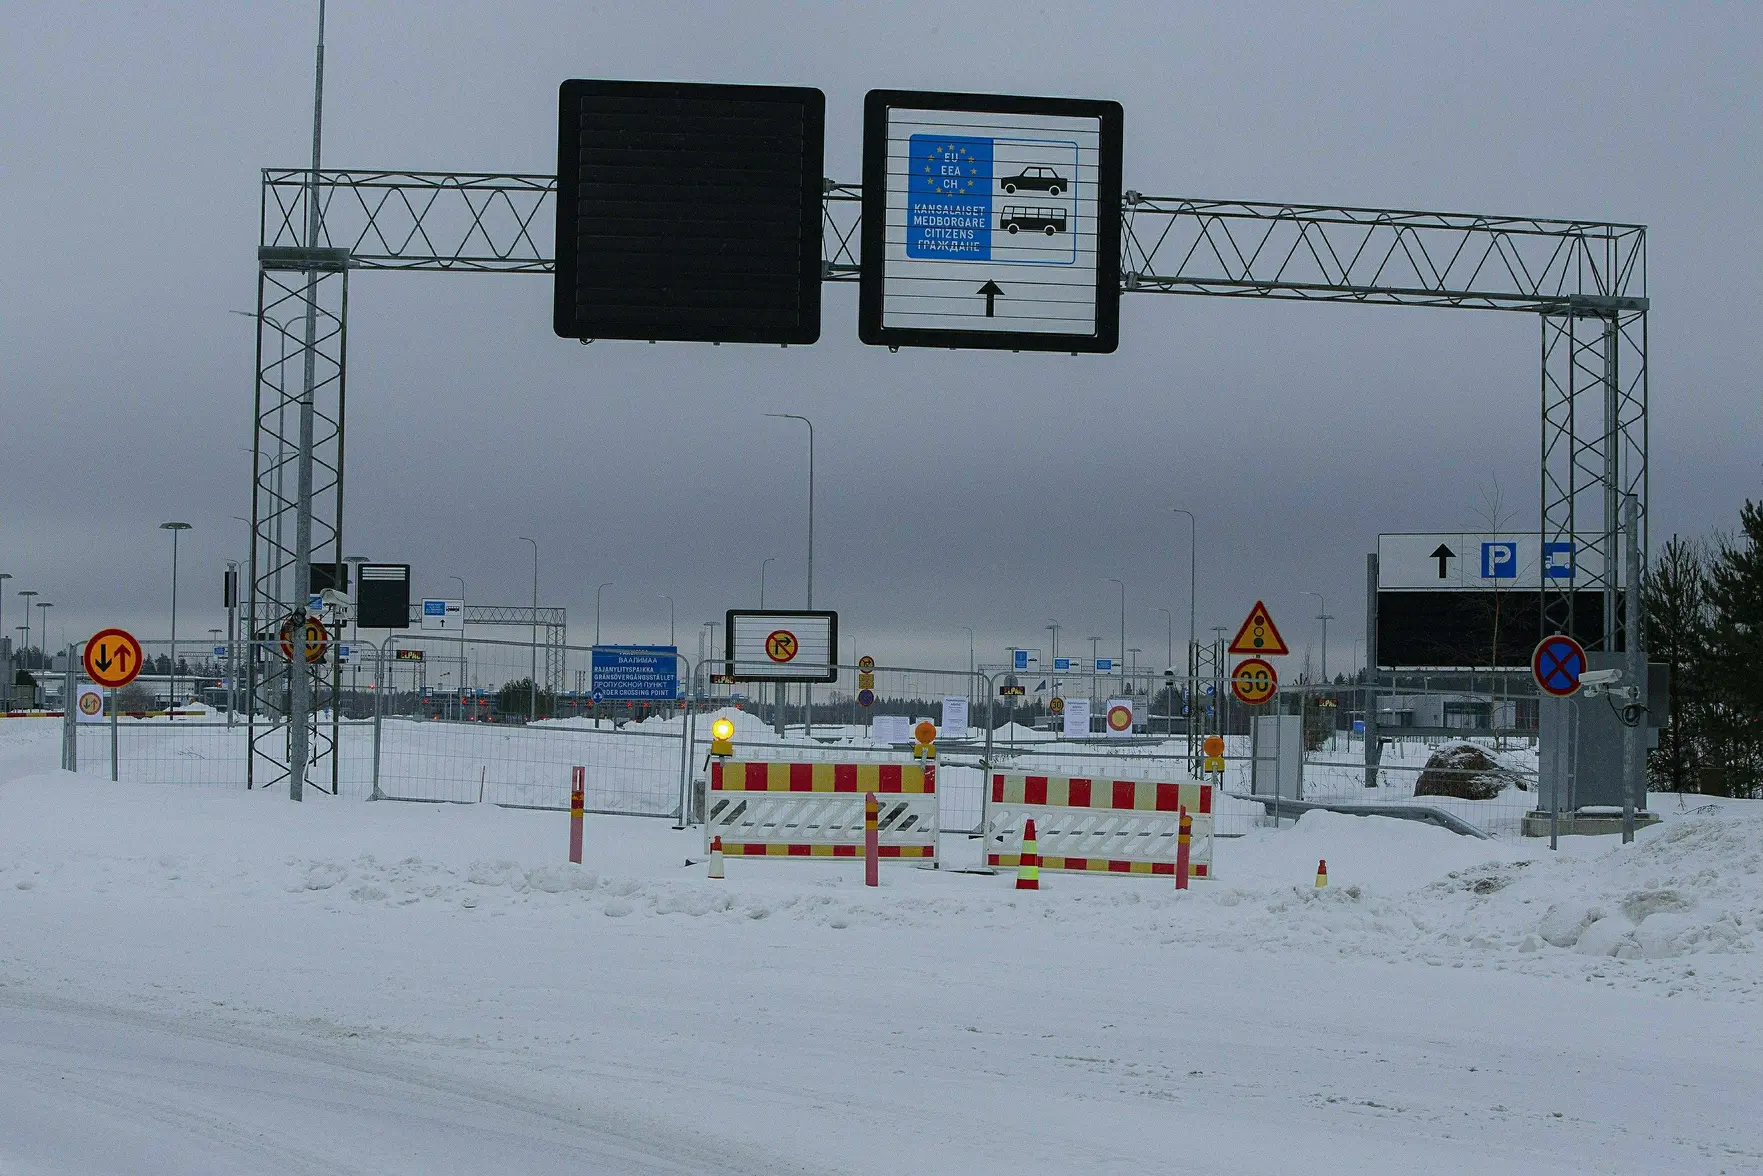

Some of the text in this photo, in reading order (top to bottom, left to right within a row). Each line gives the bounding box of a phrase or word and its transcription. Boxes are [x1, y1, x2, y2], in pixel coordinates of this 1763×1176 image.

[944, 153, 959, 163] EU
[941, 166, 961, 176] EEA
[943, 179, 958, 189] CH
[914, 203, 985, 217] KANSALAISET
[914, 215, 985, 228] MEDBORGARE
[924, 228, 974, 239] CITIZENS
[918, 240, 980, 253] ГРАЖДАНЕ
[1488, 545, 1512, 576] P
[1241, 670, 1268, 694] 30
[1051, 701, 1063, 710] 30
